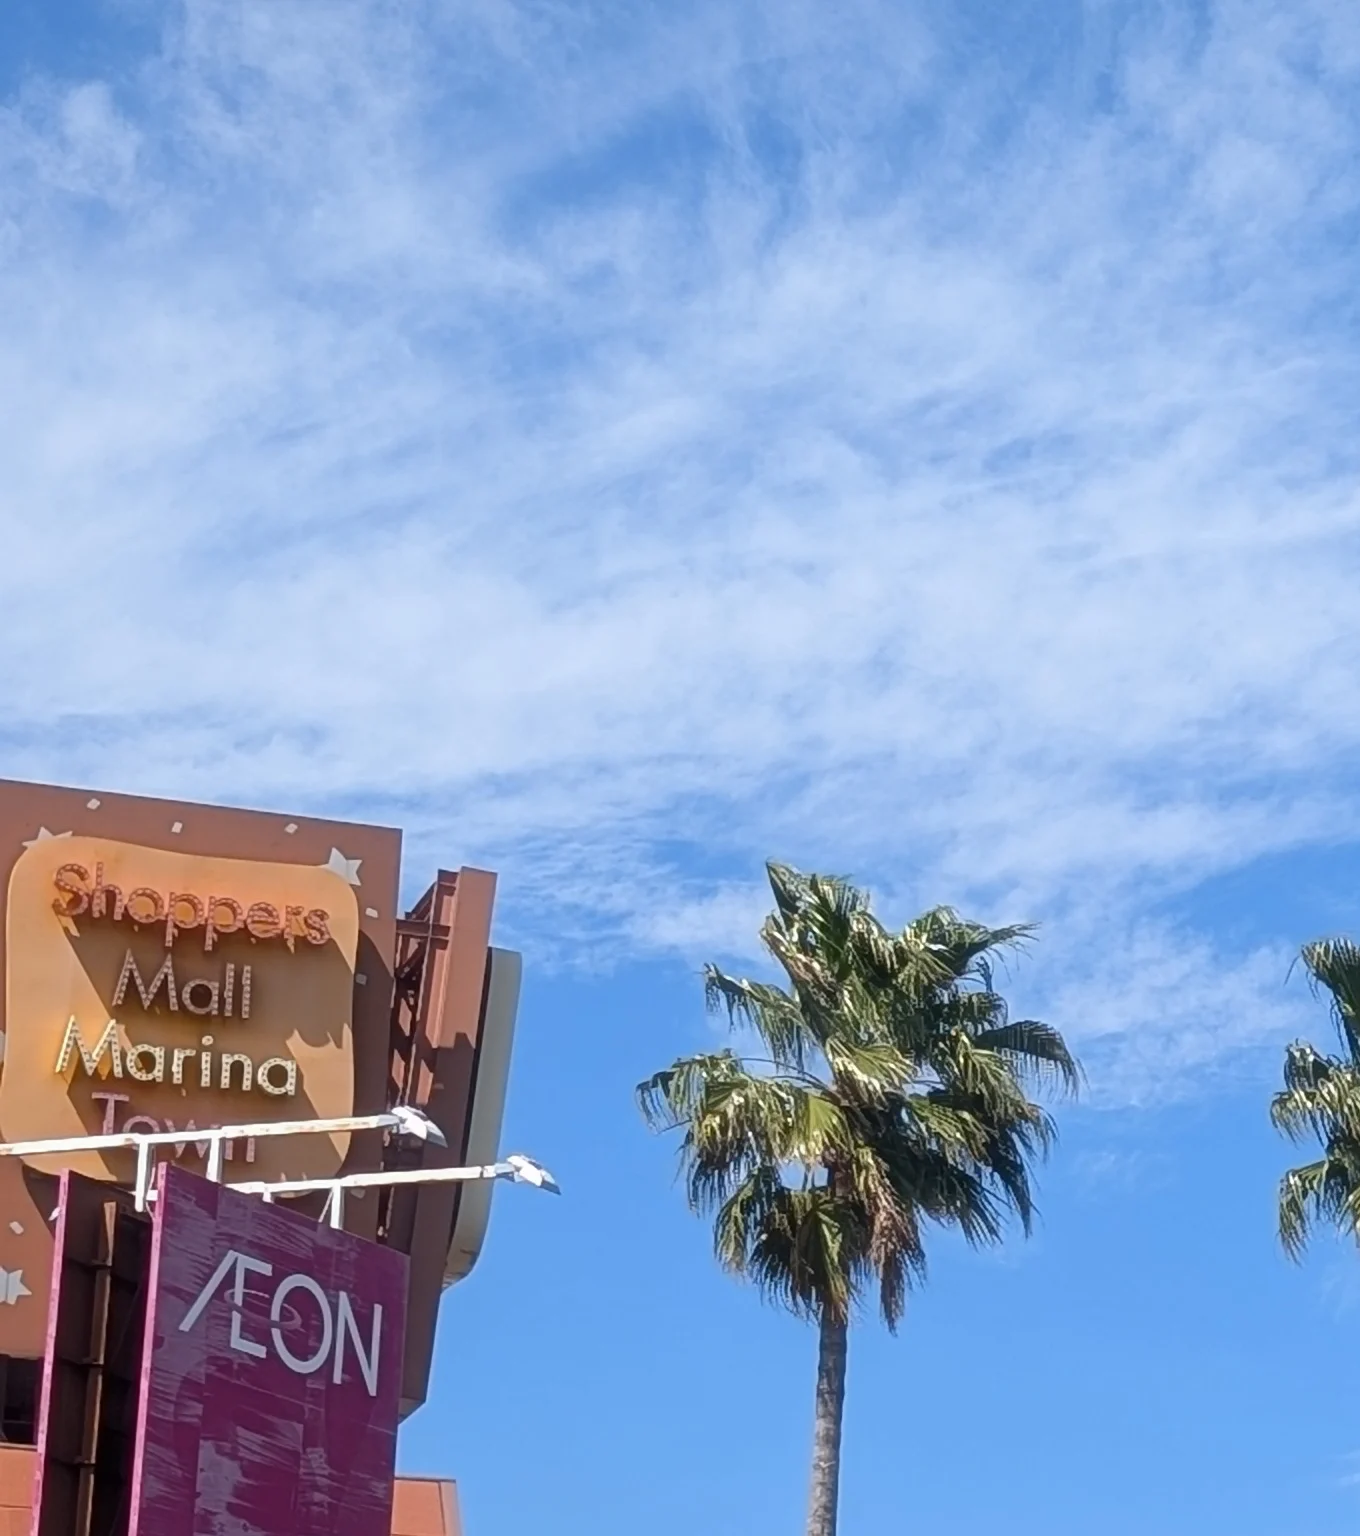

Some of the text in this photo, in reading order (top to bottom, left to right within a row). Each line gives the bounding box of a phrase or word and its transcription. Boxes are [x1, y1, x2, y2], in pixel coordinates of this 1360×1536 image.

[53, 862, 331, 951] Shoppers
[112, 949, 253, 1018] Mall
[55, 1015, 297, 1096] Marina
